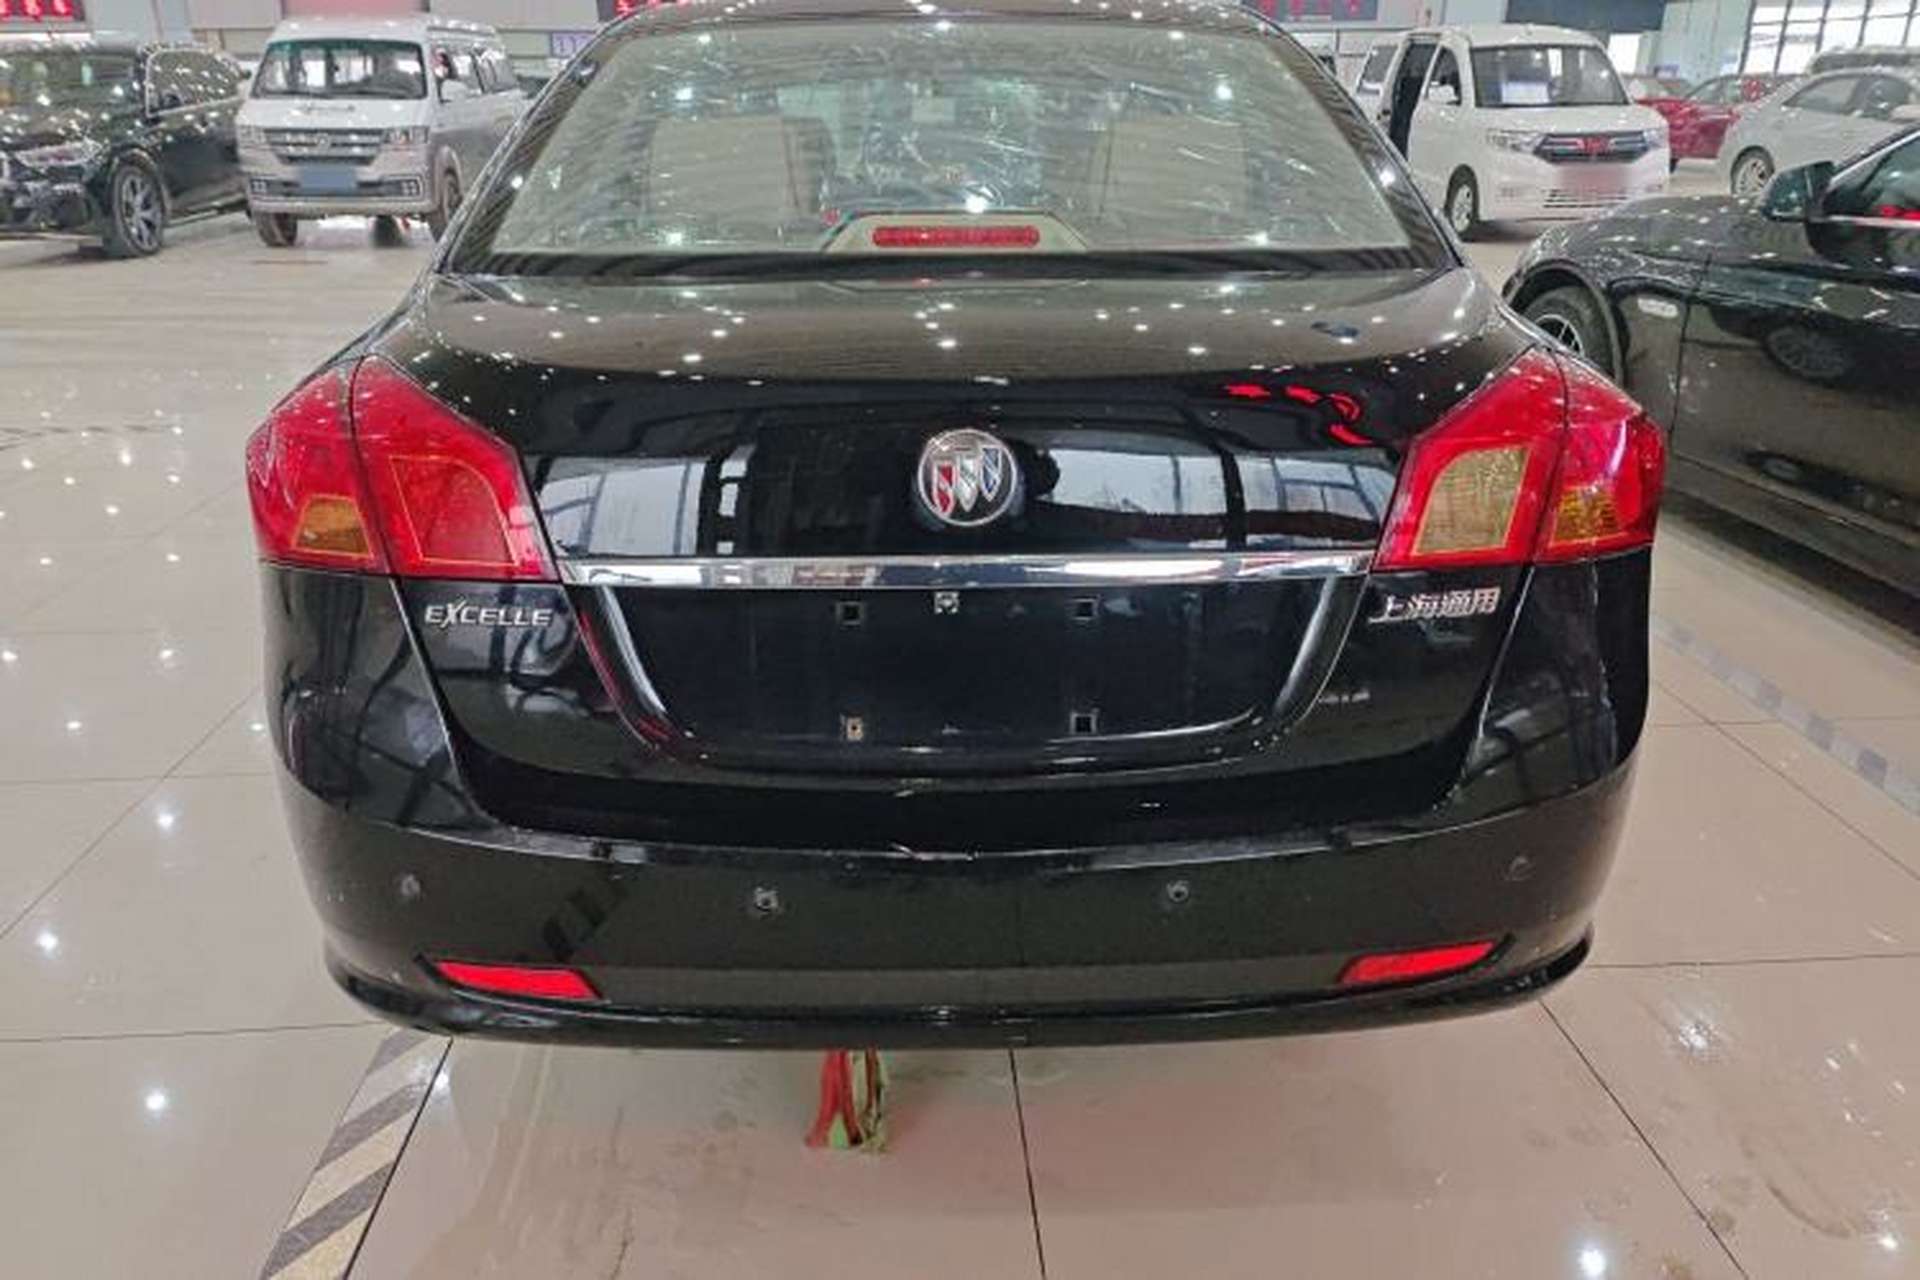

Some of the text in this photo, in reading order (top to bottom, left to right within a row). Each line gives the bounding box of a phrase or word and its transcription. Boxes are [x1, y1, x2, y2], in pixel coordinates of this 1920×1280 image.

[424, 599, 553, 628] EXCELLE
[1368, 586, 1501, 624] 上海通用
